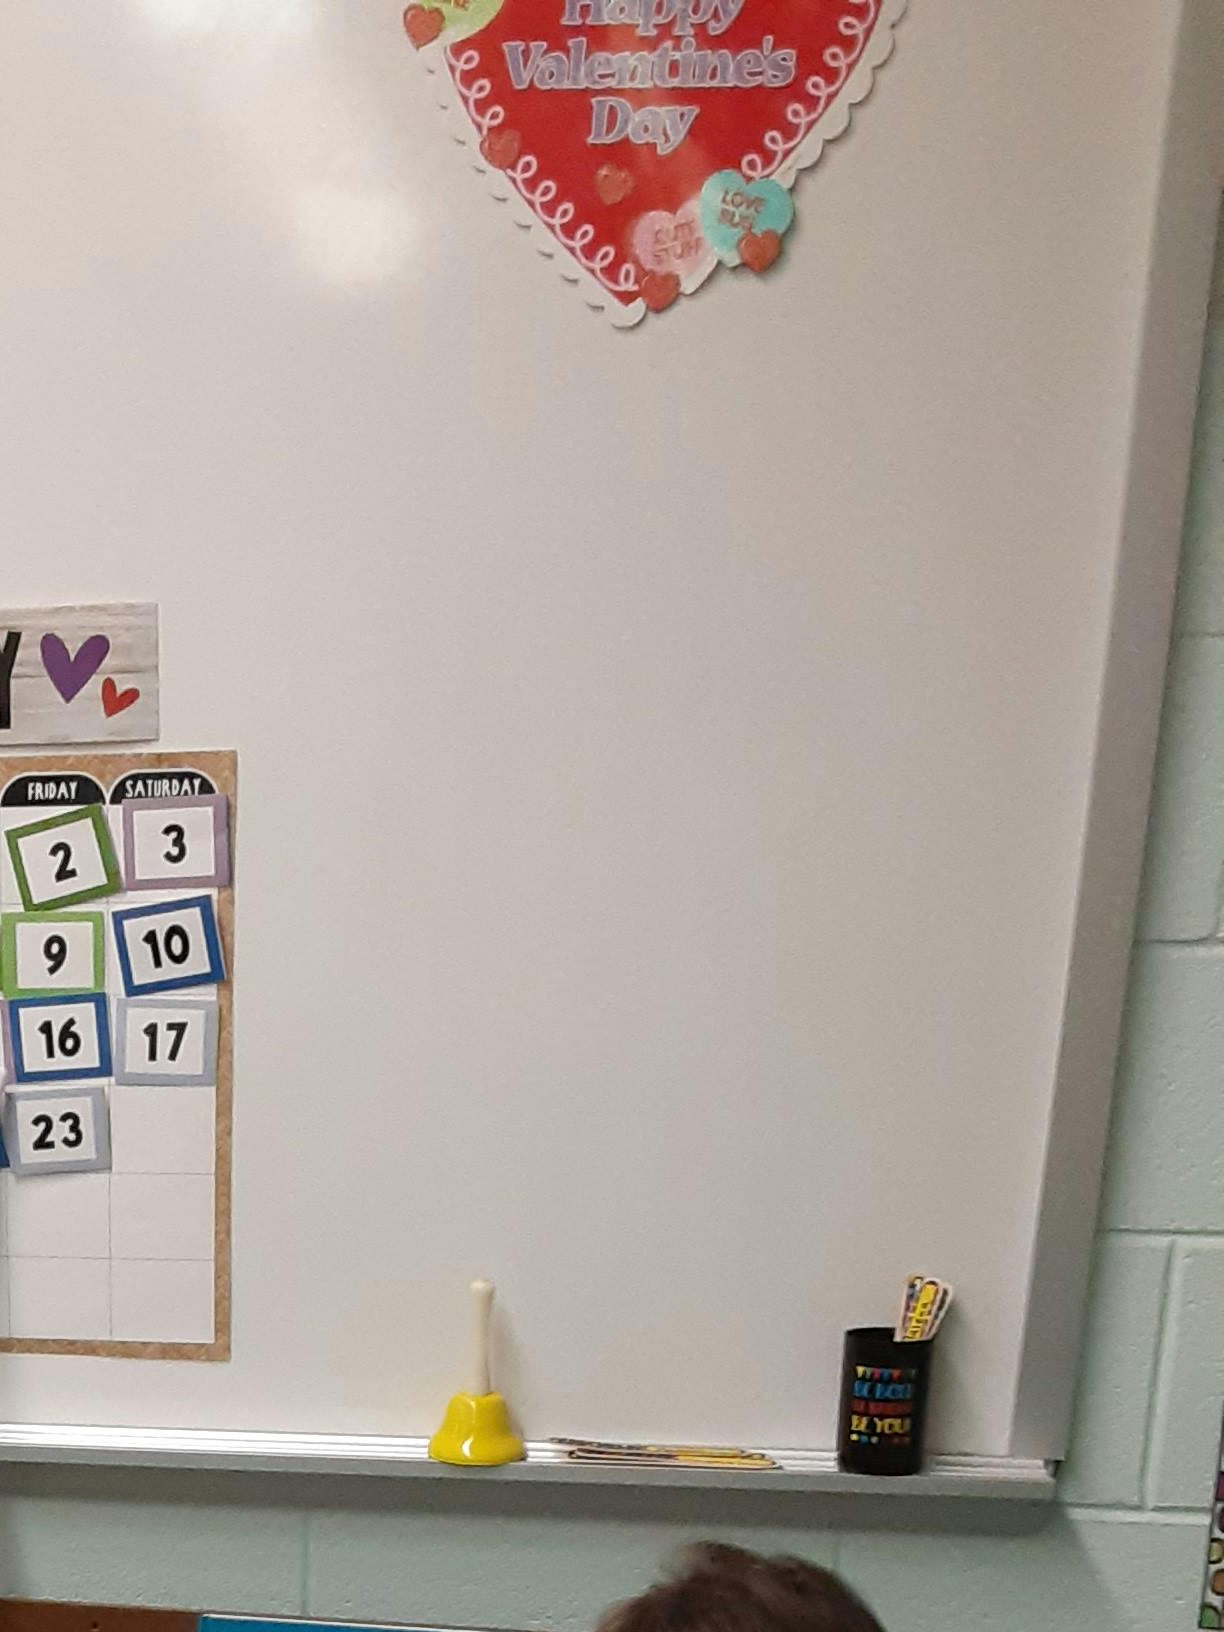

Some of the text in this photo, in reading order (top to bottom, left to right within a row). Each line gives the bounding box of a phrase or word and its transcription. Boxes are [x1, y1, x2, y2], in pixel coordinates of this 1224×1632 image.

[503, 36, 797, 90] Valentine's
[587, 97, 700, 155] Day
[27, 781, 78, 800] FRIDAY
[125, 778, 202, 798] SATURDAY
[50, 842, 77, 882] 2
[163, 825, 186, 864] 3
[43, 935, 67, 975] 9
[142, 924, 190, 969] 10
[38, 1018, 81, 1059] 16
[143, 1022, 188, 1062] 17
[31, 1111, 83, 1151] 23
